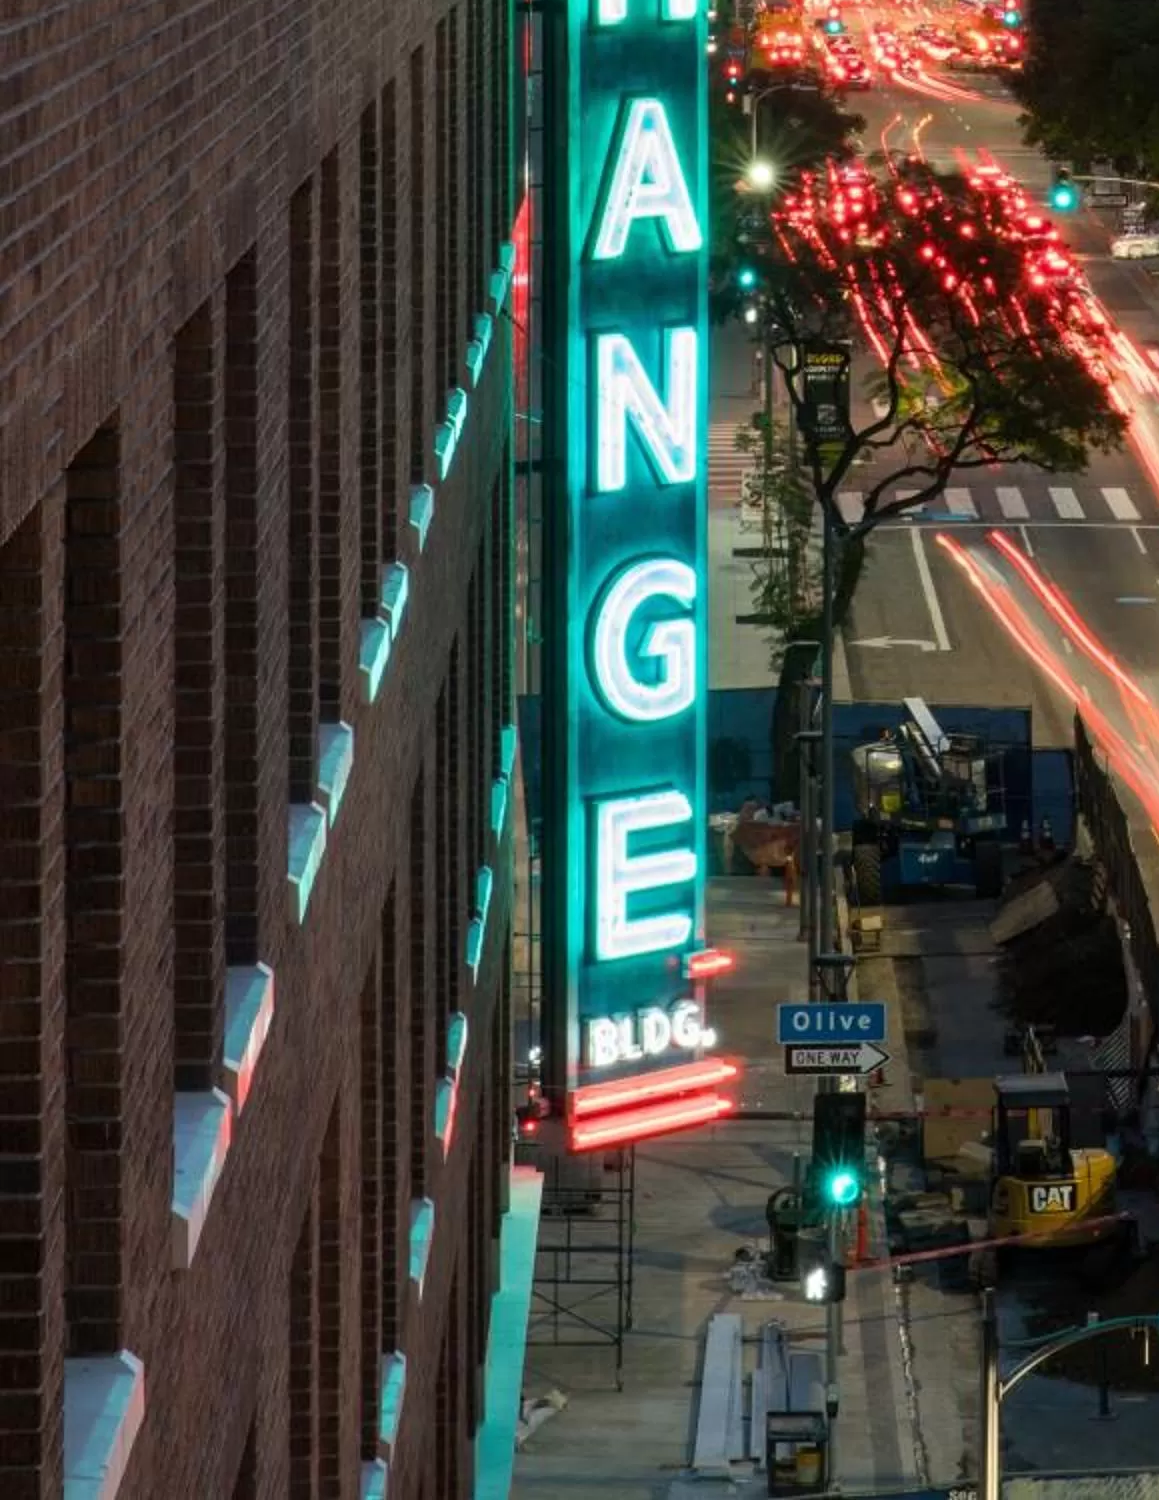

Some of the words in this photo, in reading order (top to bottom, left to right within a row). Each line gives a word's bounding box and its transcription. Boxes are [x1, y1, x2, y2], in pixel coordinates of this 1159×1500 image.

[588, 1000, 718, 1067] BLDG.
[792, 1011, 872, 1032] Olive
[795, 1051, 826, 1065] ONE
[829, 1051, 860, 1065] WAY
[1032, 1185, 1073, 1212] CAT
